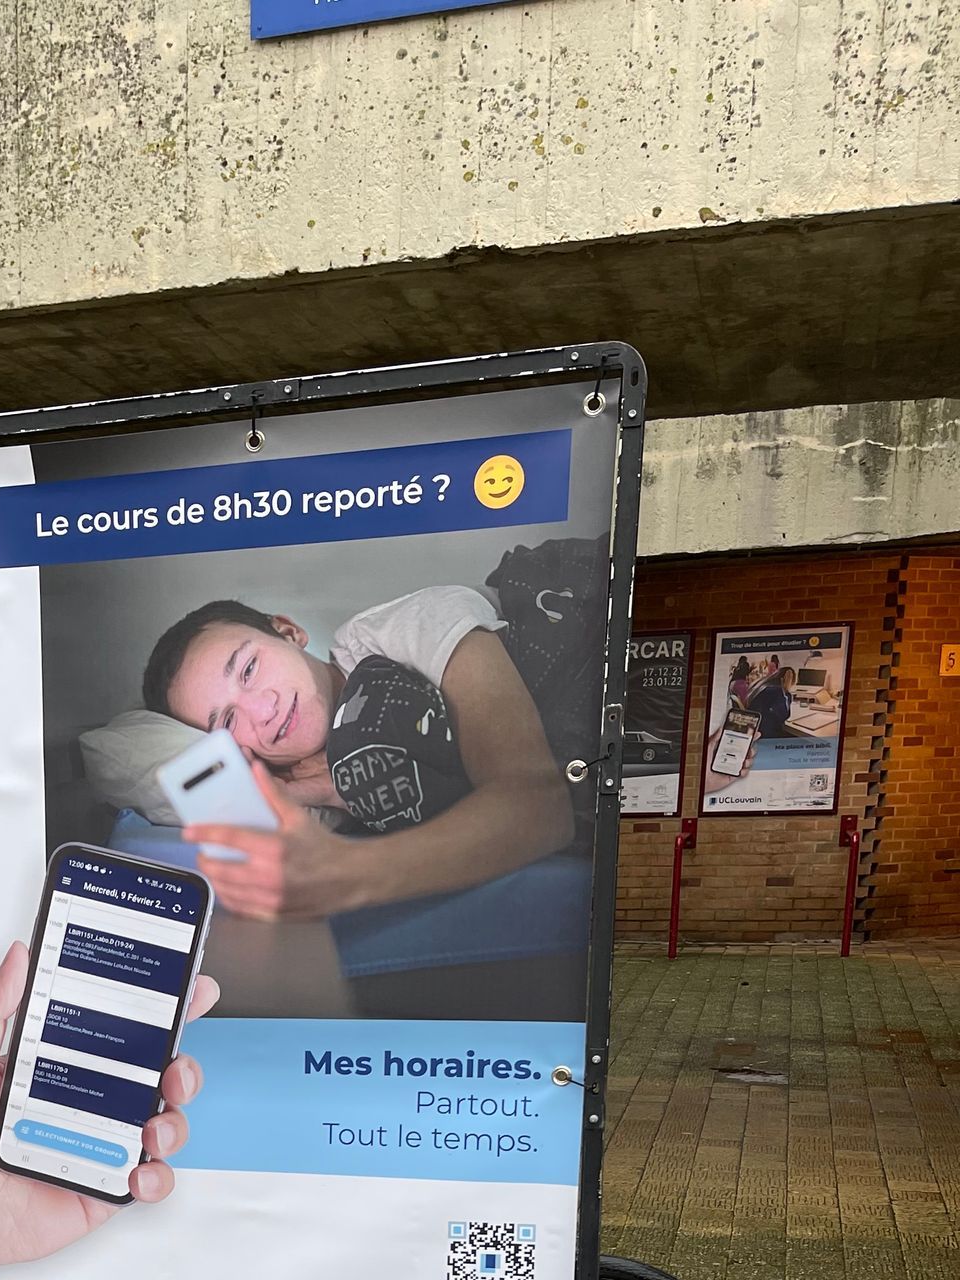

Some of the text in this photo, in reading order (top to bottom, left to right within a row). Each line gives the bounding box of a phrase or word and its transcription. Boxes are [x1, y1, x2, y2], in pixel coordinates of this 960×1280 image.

[35, 473, 452, 538] Le cours de 8h30 reporté ?
[642, 676, 682, 688] 23.01.22
[643, 666, 683, 677] 17.12.21
[336, 751, 405, 792] GAME
[718, 796, 762, 805] UCLouvain
[68, 859, 85, 870] 12:00
[83, 881, 119, 900] Mercredi,
[120, 890, 127, 900] 9
[127, 893, 154, 907] Février
[304, 1049, 542, 1081] Mes horaires.
[416, 1090, 540, 1118] Partout.
[322, 1122, 538, 1157] Tout le temps.
